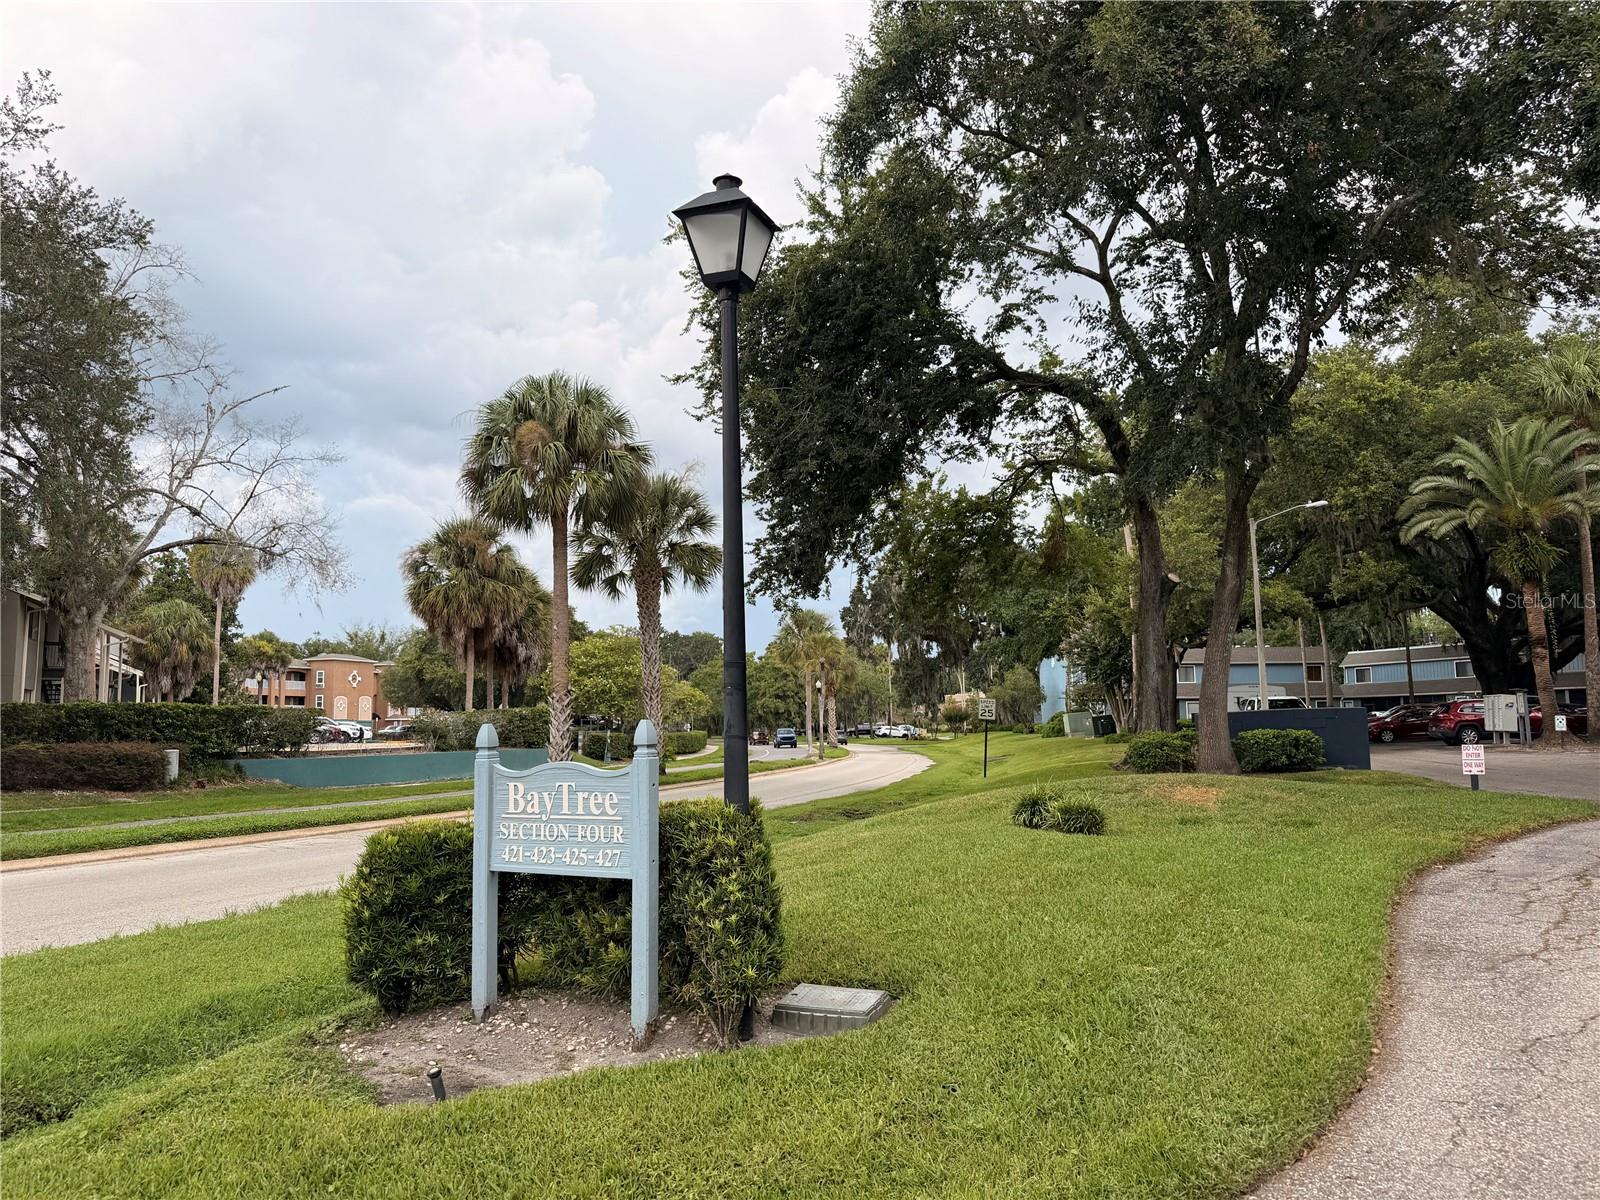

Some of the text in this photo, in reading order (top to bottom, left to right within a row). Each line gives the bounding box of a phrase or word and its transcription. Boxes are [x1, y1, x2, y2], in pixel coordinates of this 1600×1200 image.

[980, 708, 994, 718] 25
[506, 781, 619, 821] BayTree
[499, 822, 624, 844] SECTION FOUR
[502, 845, 621, 867] 421-423-425-427
